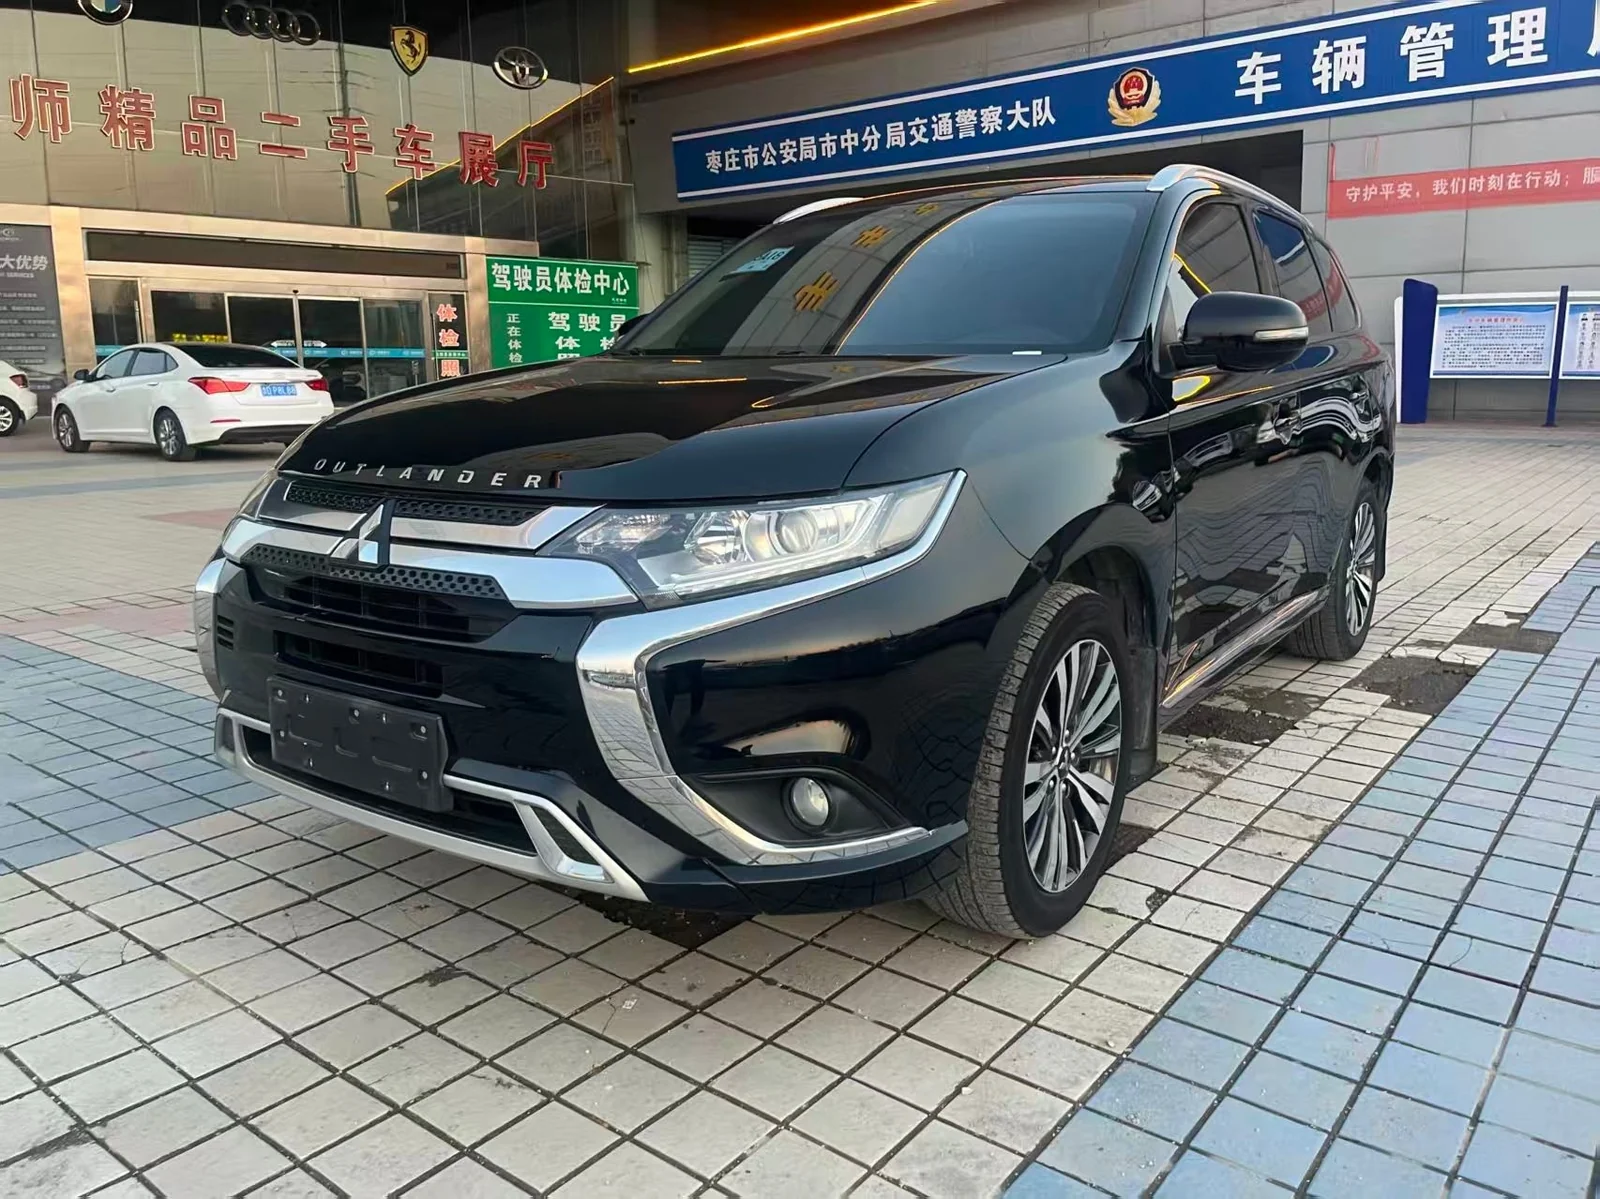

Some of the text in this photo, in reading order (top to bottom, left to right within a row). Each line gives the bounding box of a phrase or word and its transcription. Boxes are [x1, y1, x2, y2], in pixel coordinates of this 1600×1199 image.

[1235, 5, 1600, 105] 车辆管理
[10, 73, 554, 190] 师精品二手车展厅
[705, 96, 1057, 175] 枣庄市公安局市中分局交通警察大队
[491, 262, 630, 296] 驾驶员体检中心
[314, 458, 542, 488] OUTLANDER
